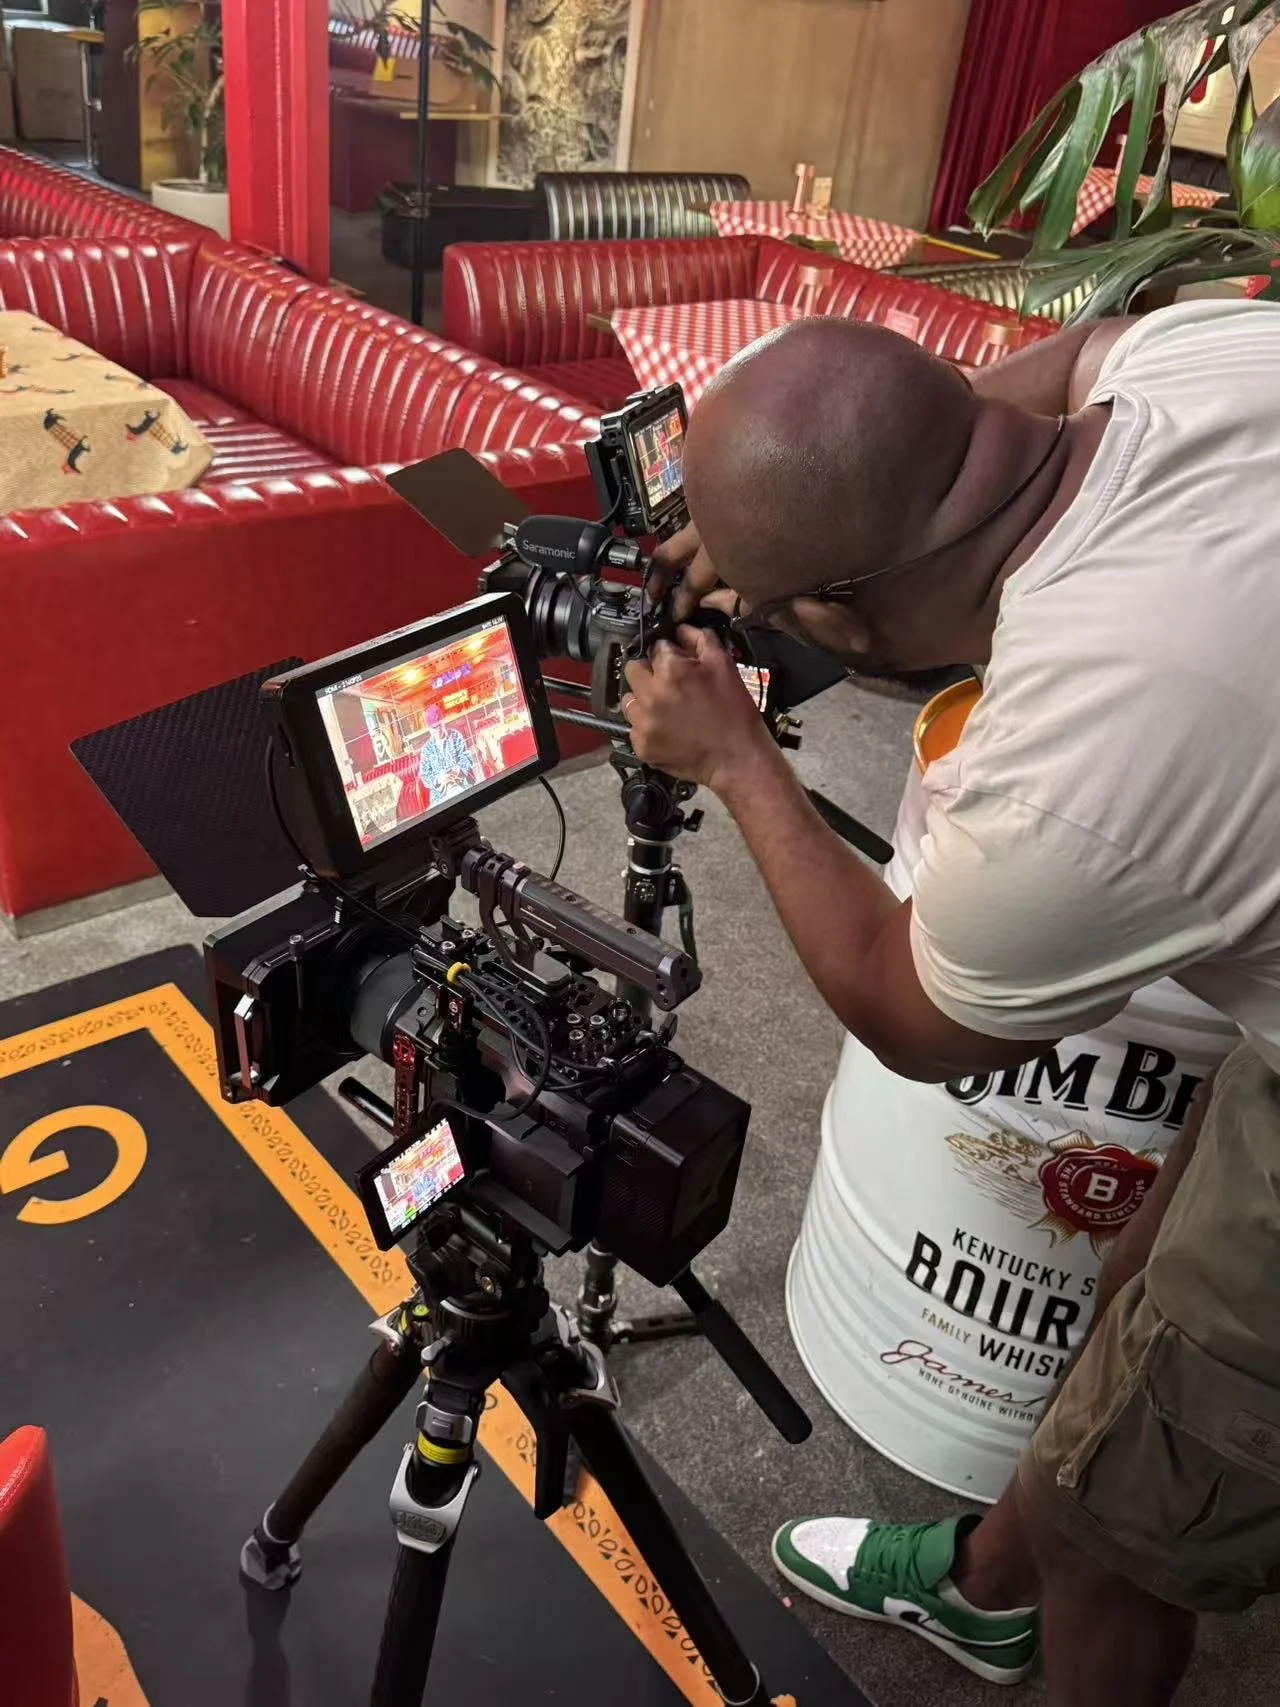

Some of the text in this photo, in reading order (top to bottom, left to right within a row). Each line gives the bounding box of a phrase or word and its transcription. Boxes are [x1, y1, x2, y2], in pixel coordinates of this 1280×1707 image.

[523, 540, 576, 559] Saramonic
[1085, 1171, 1119, 1202] B
[952, 1227, 1072, 1291] KENTUCKY
[922, 1307, 972, 1344] FAMILY
[918, 1368, 944, 1389] NONE
